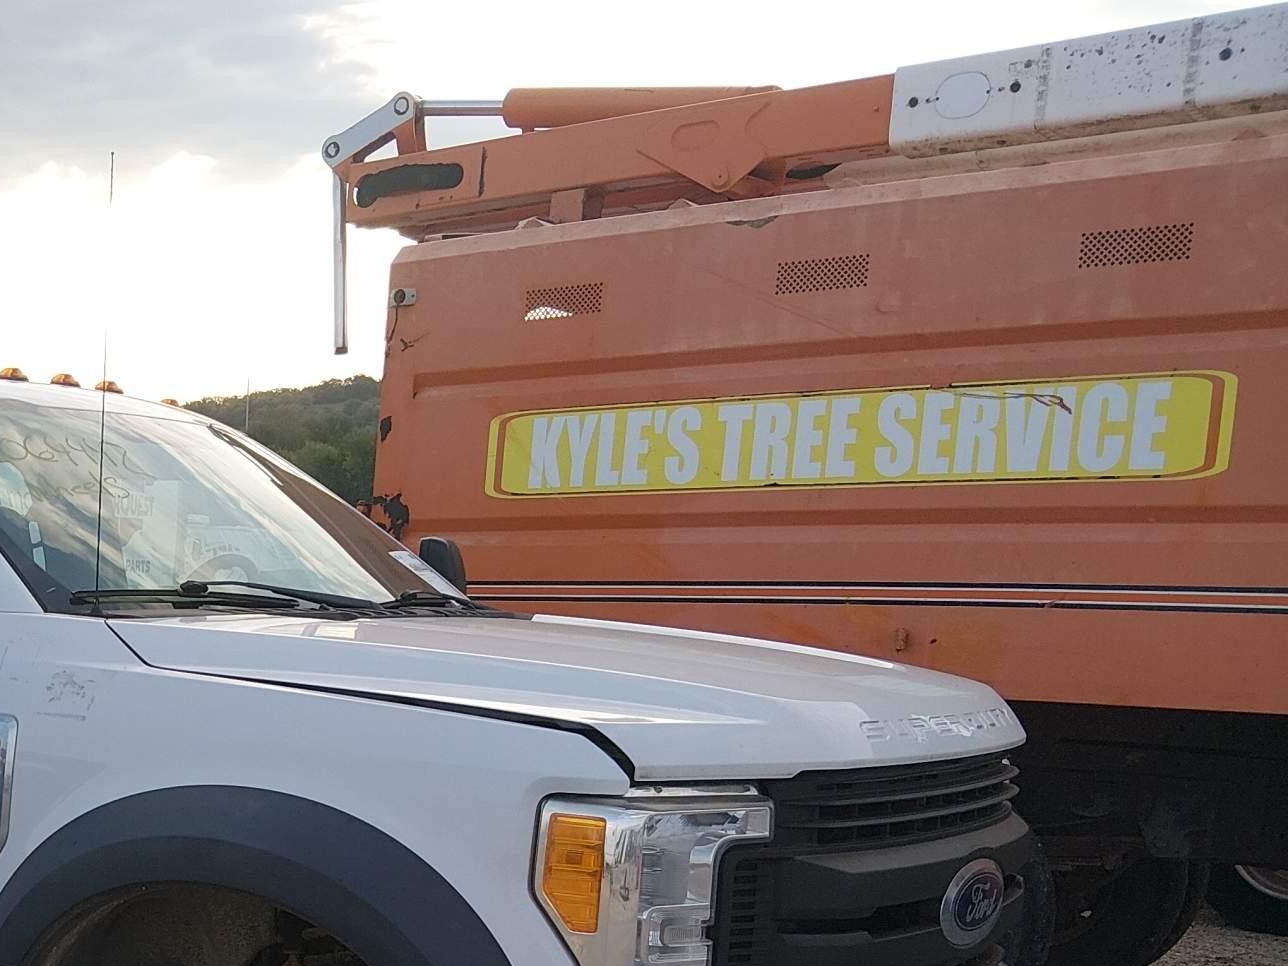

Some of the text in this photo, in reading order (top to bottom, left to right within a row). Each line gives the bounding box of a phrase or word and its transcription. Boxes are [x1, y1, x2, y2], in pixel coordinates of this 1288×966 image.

[528, 379, 1172, 489] KYLE'S TREE SERVICE
[966, 882, 997, 922] Ford
